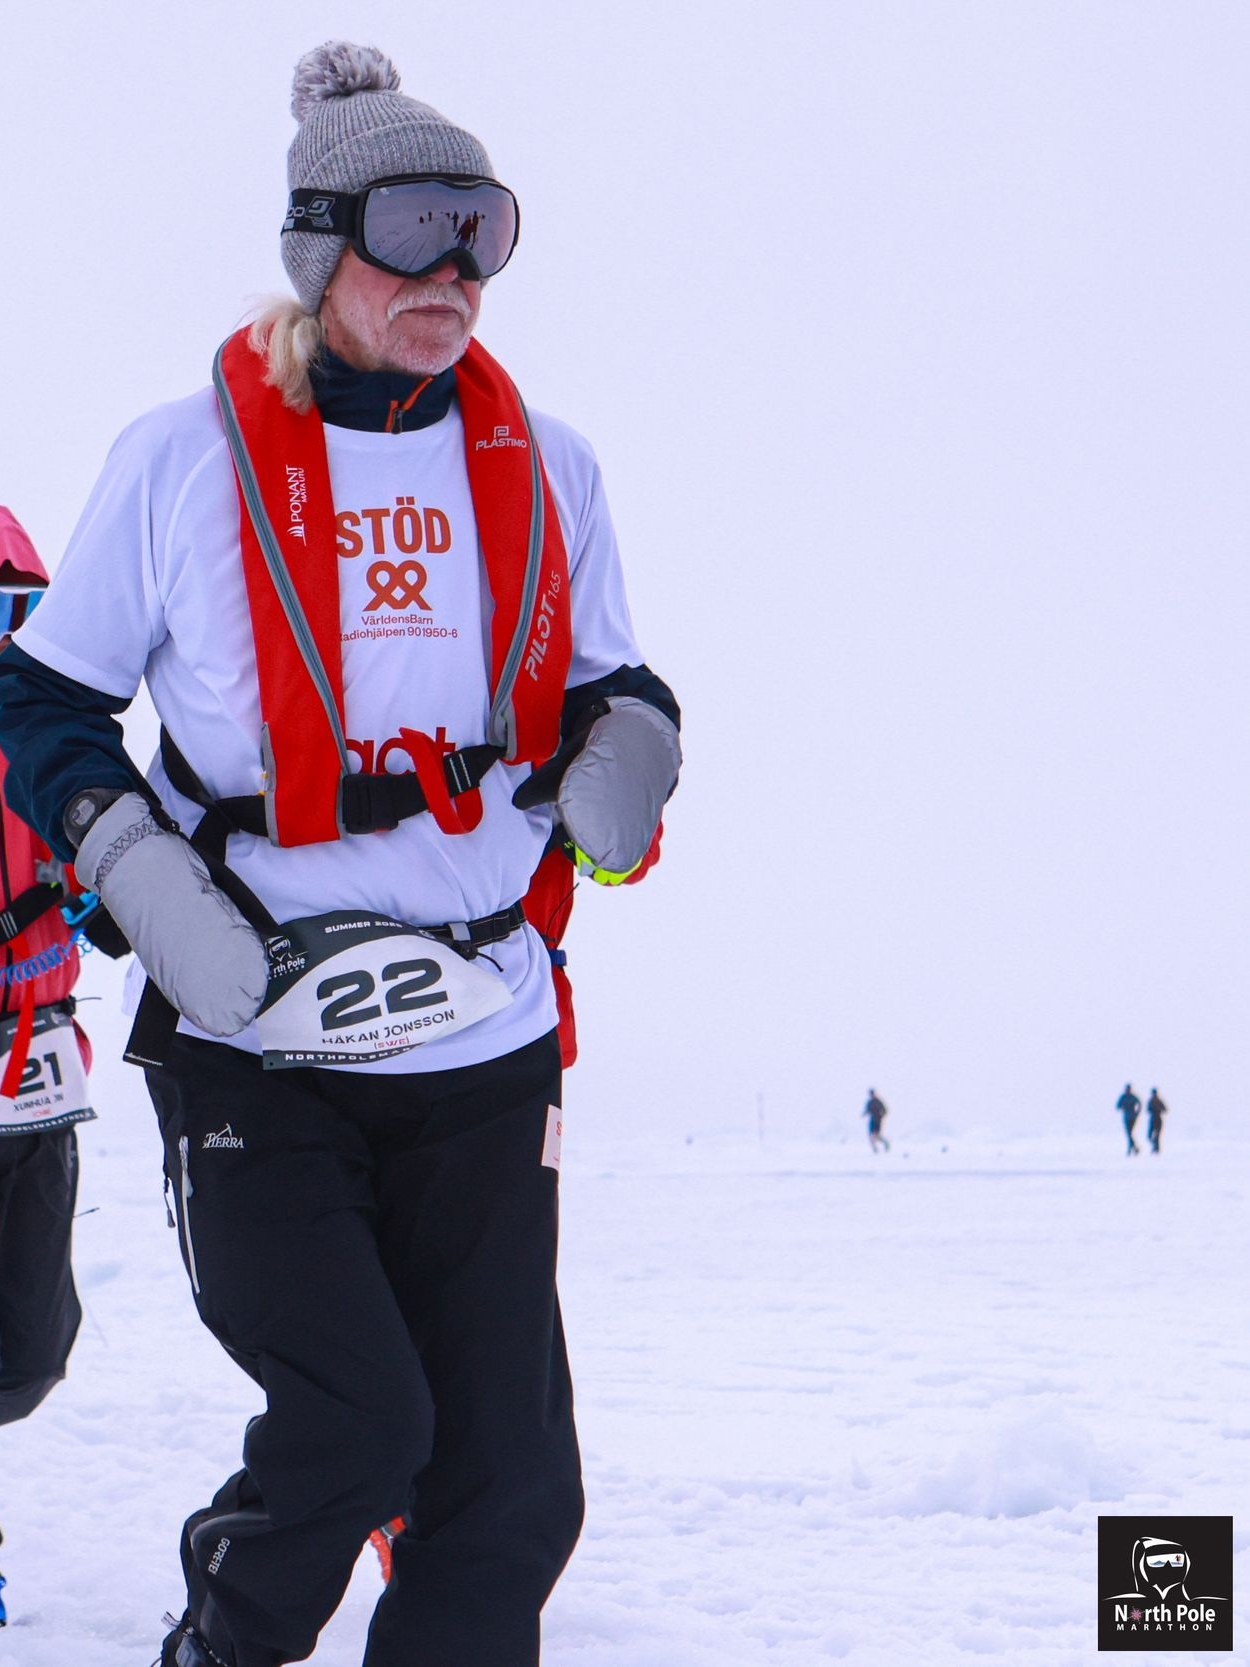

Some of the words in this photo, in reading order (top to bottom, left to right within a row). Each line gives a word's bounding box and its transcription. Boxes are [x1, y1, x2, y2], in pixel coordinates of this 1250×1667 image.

[476, 438, 527, 451] PLASTIMO
[286, 464, 303, 523] PONANT
[335, 496, 452, 559] STÖD
[340, 626, 406, 643] adiohjälpen
[524, 593, 555, 682] PILOT
[548, 570, 561, 600] 165
[324, 920, 371, 934] SUMMER
[287, 957, 306, 970] Pole
[316, 957, 449, 1032] 22
[321, 1030, 380, 1045] HÅKAN
[383, 1009, 455, 1038] JONSSON
[15, 1051, 63, 1097] 21
